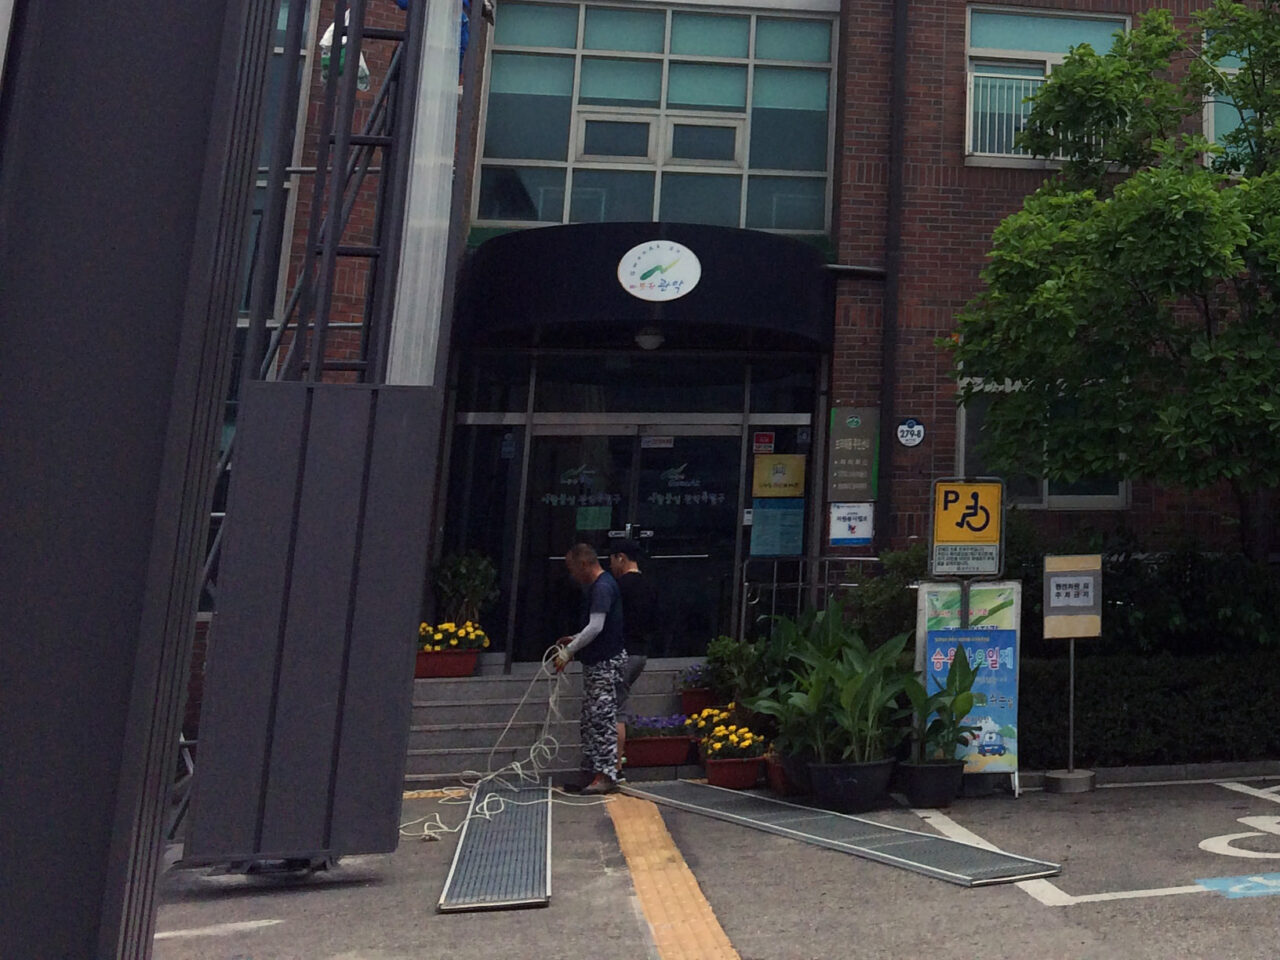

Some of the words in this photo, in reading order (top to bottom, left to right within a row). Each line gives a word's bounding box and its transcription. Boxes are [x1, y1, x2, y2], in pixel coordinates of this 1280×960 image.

[899, 429, 922, 439] 279-8
[943, 490, 960, 511] P
[931, 647, 1013, 672] 승용요일제
